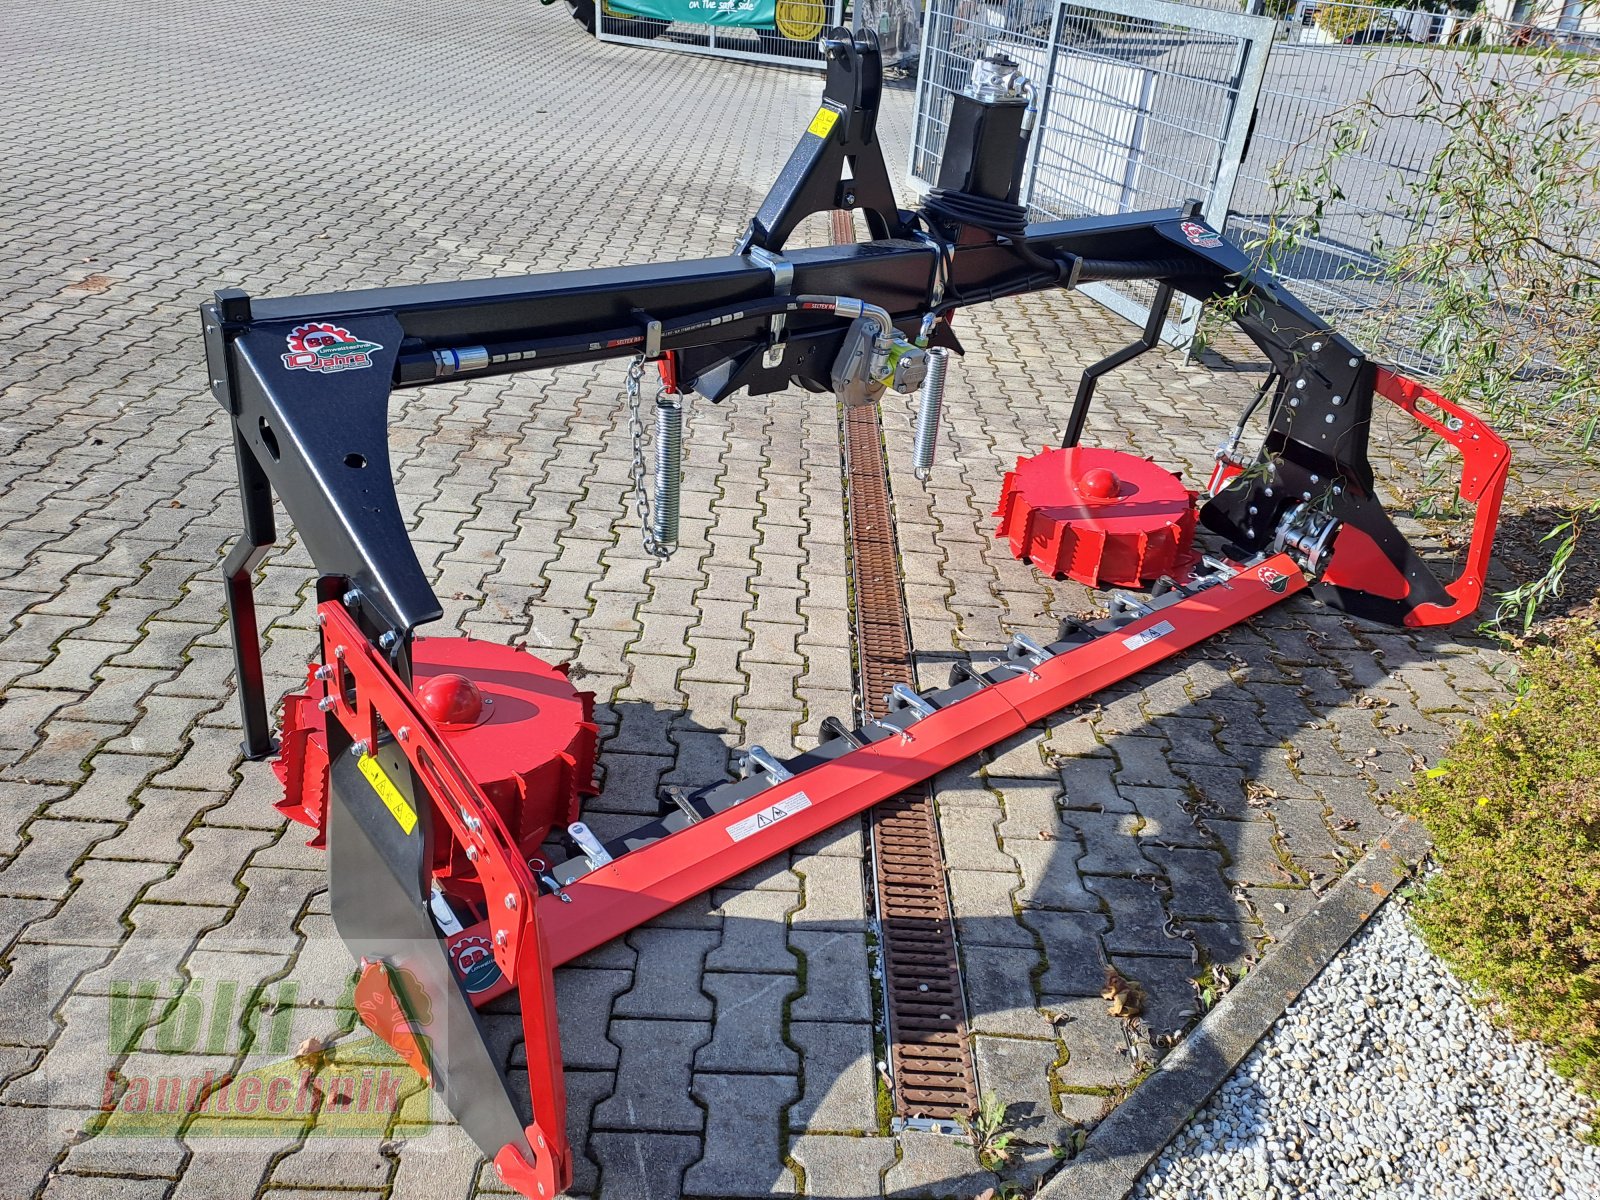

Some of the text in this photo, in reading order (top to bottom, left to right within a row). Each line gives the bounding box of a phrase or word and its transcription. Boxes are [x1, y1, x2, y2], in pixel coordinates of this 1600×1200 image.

[689, 0, 754, 13] on the safe side
[306, 336, 336, 348] BB
[285, 353, 316, 367] 10
